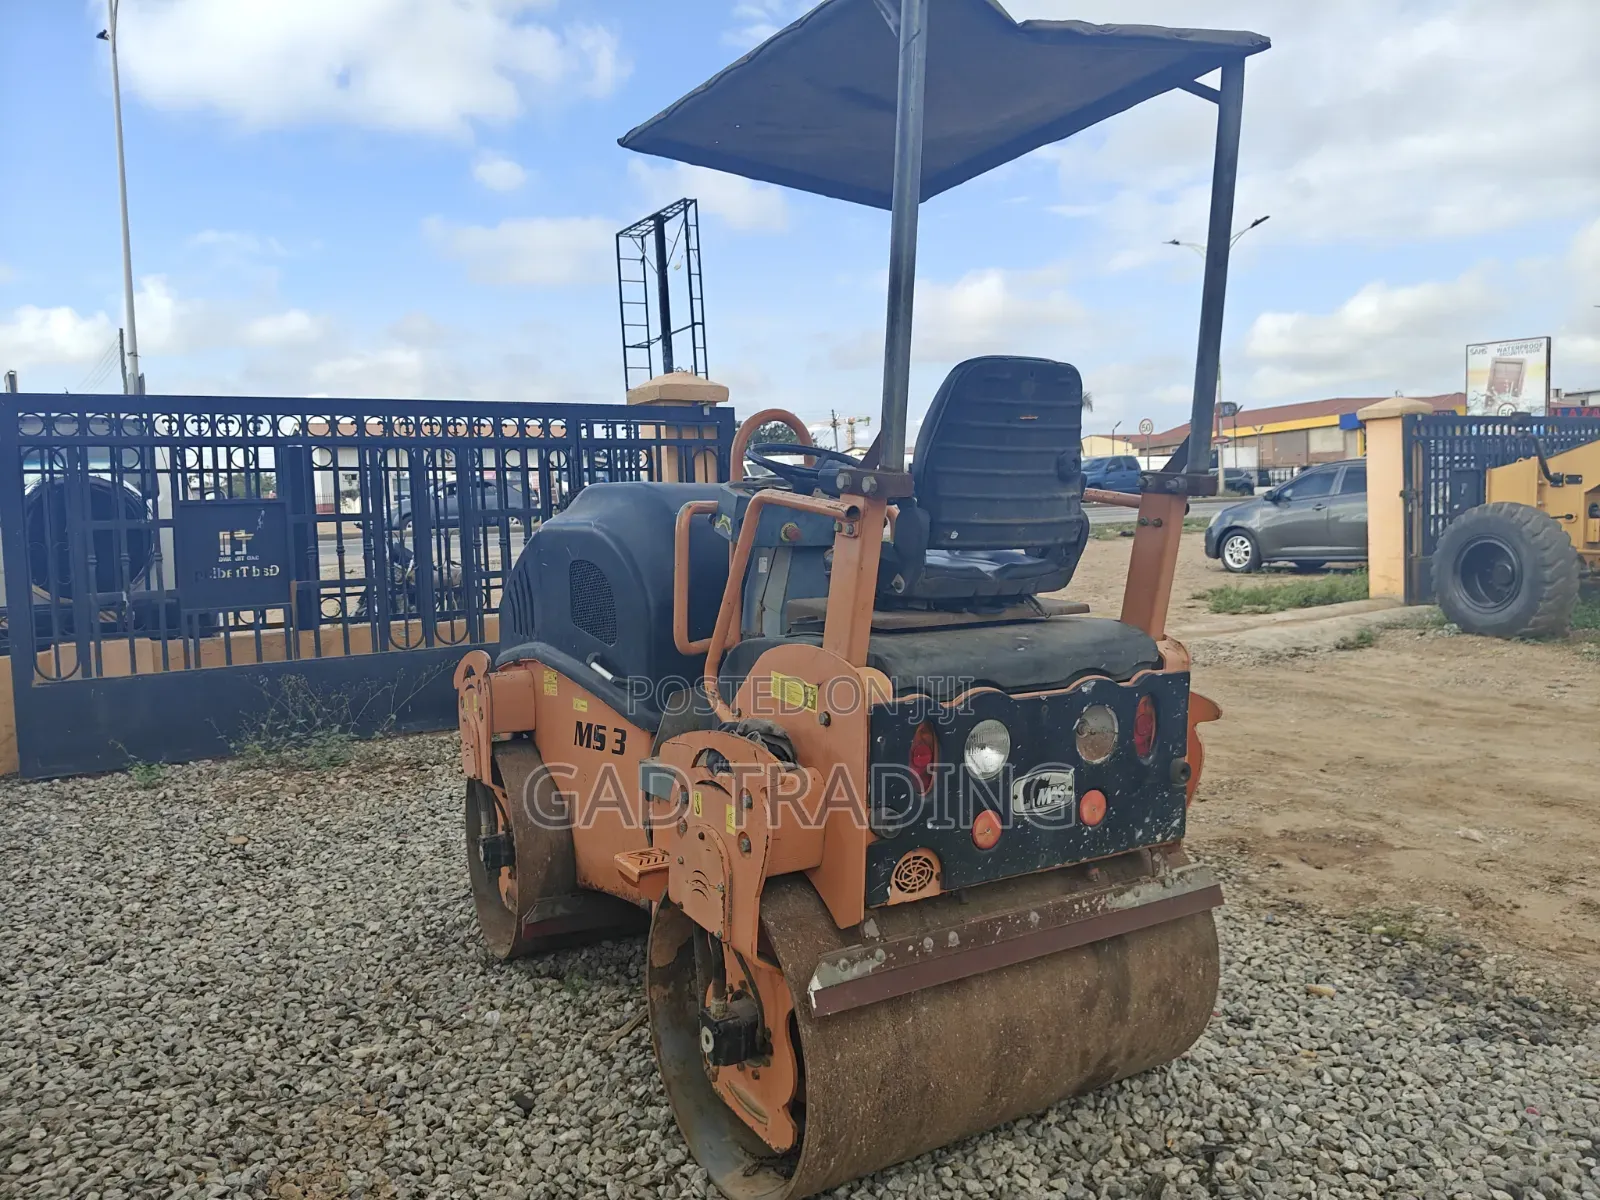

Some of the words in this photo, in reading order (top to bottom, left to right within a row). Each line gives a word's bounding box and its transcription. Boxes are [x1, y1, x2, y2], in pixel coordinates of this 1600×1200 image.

[1496, 342, 1544, 353] WATERPROOF
[1141, 423, 1151, 432] 50
[574, 720, 607, 752] MS
[611, 727, 627, 756] 3
